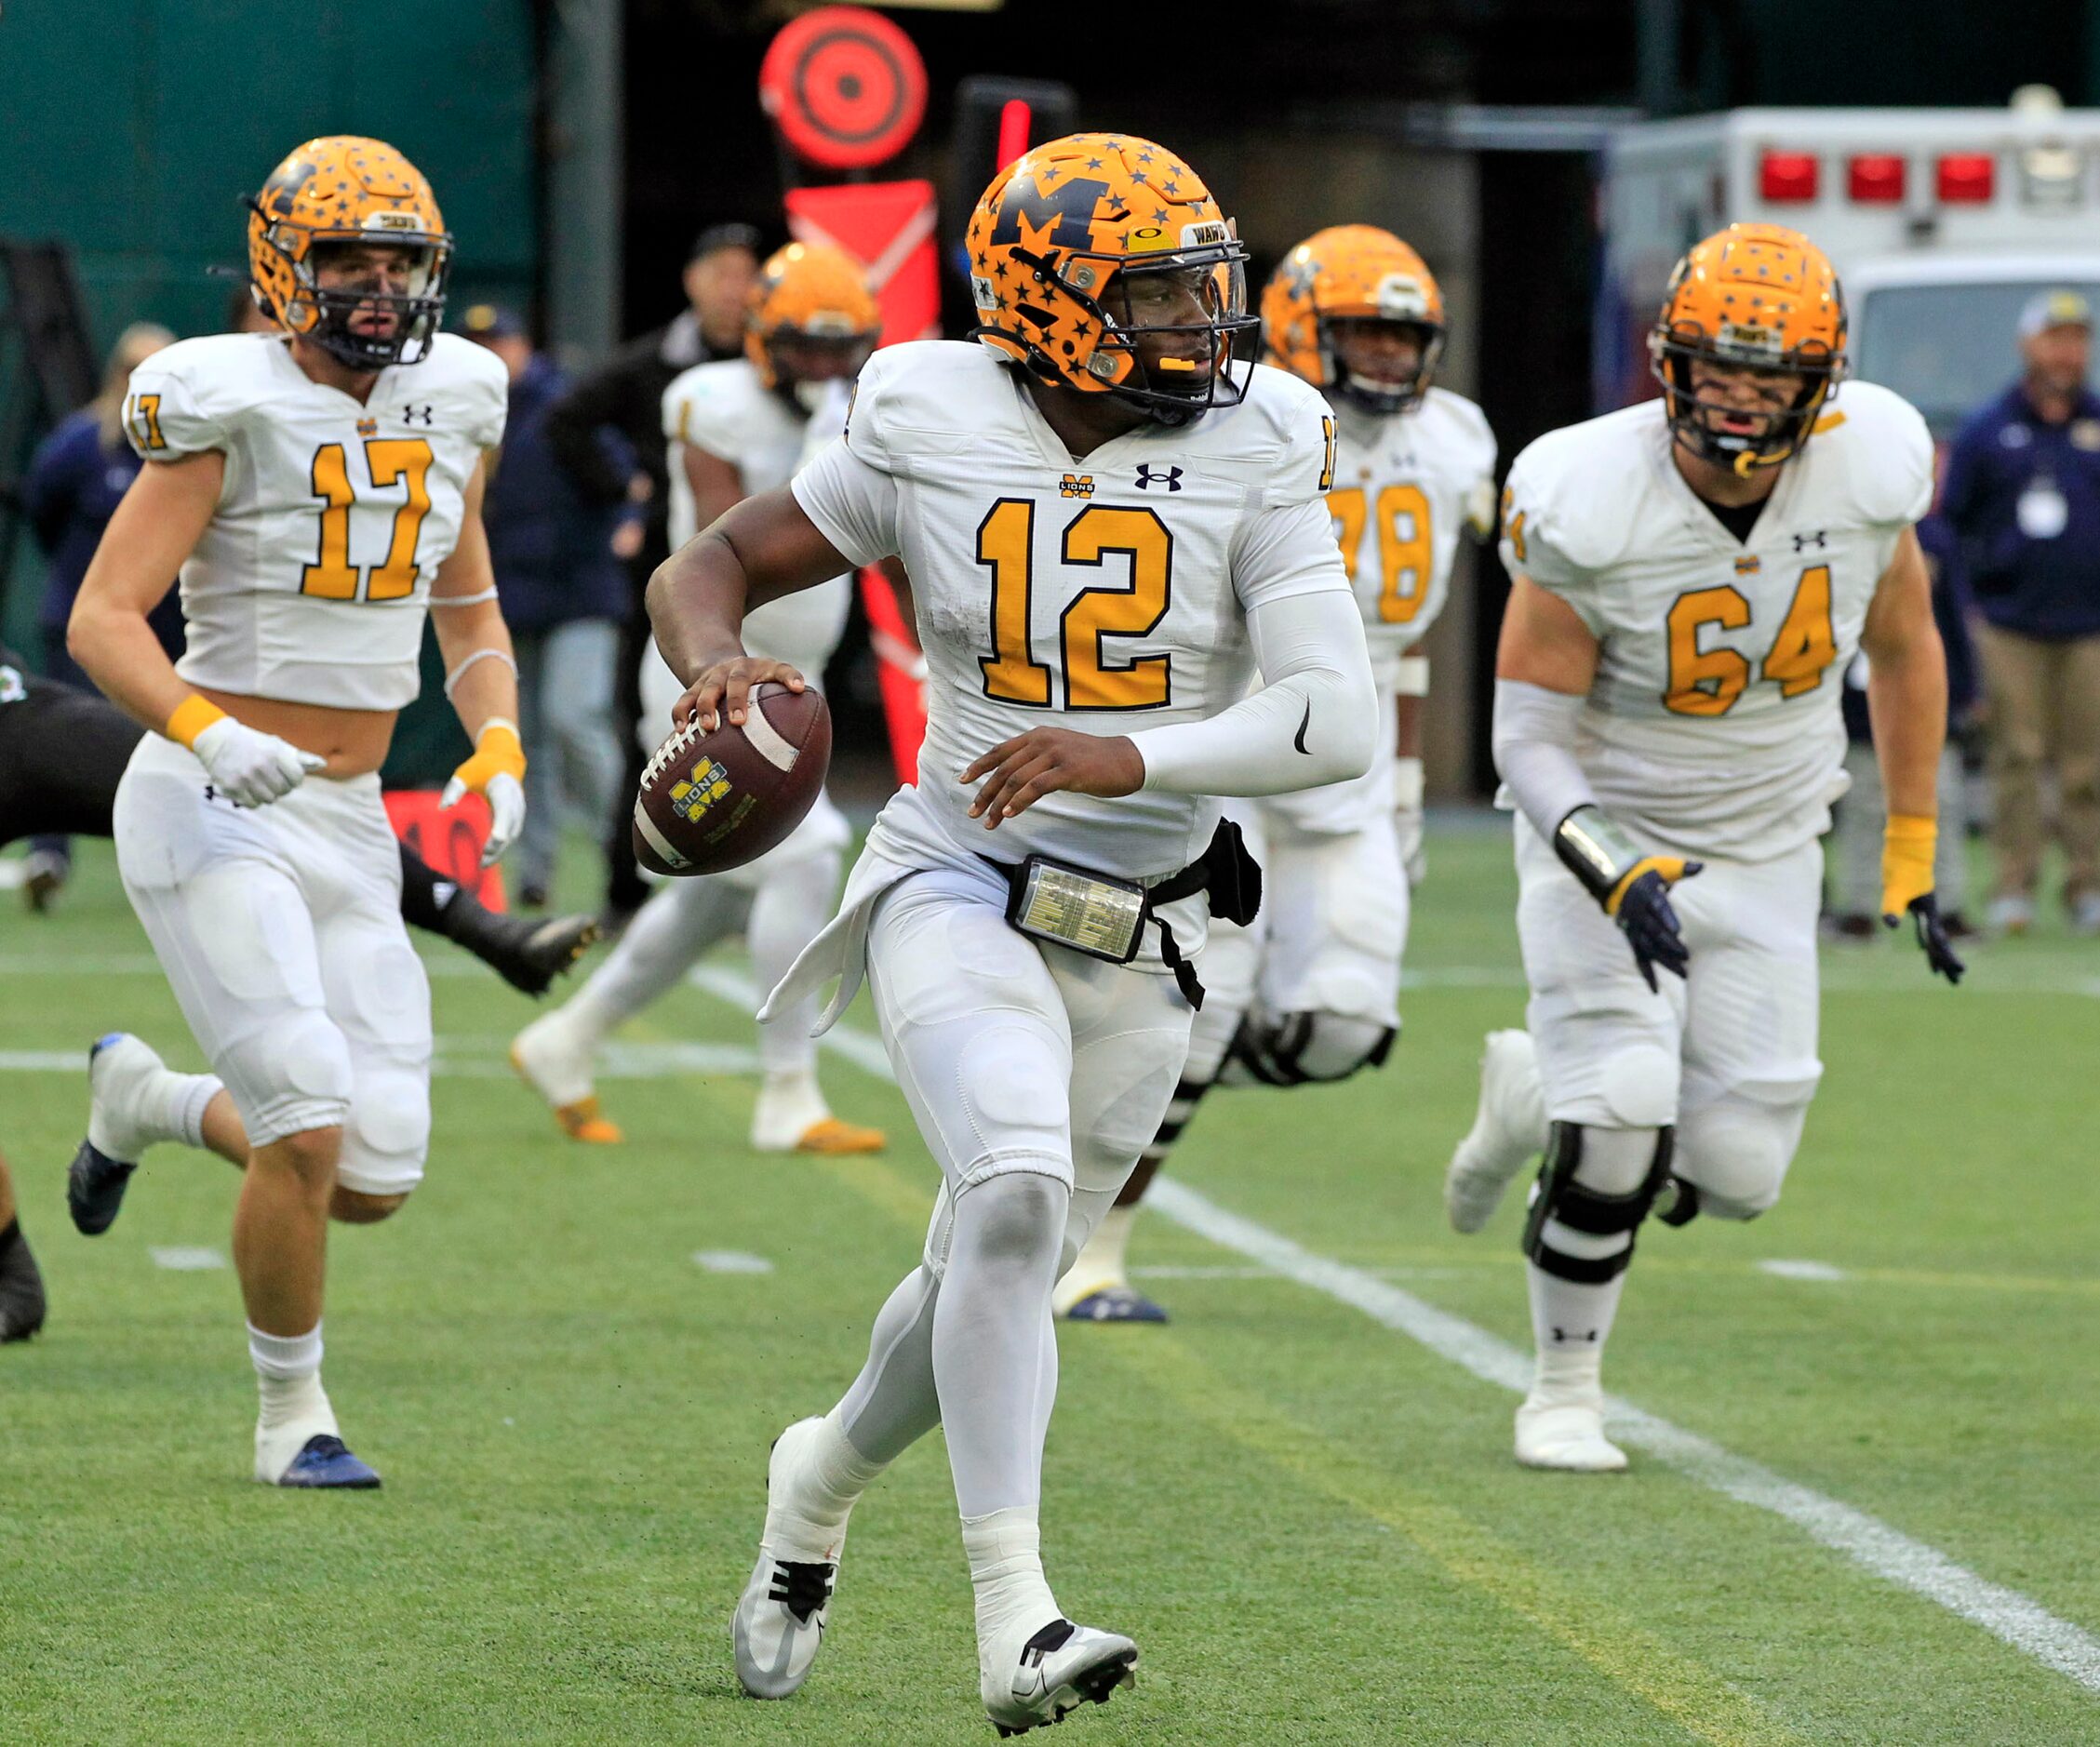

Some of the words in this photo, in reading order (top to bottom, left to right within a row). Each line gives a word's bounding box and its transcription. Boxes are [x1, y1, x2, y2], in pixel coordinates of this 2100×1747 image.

[990, 176, 1110, 252] M
[1061, 483, 1093, 491] LIONS
[1318, 415, 1340, 490] 1
[300, 438, 435, 601] 17
[976, 497, 1174, 711] 12
[1662, 564, 1837, 716] 64
[677, 768, 720, 812] LIONS
